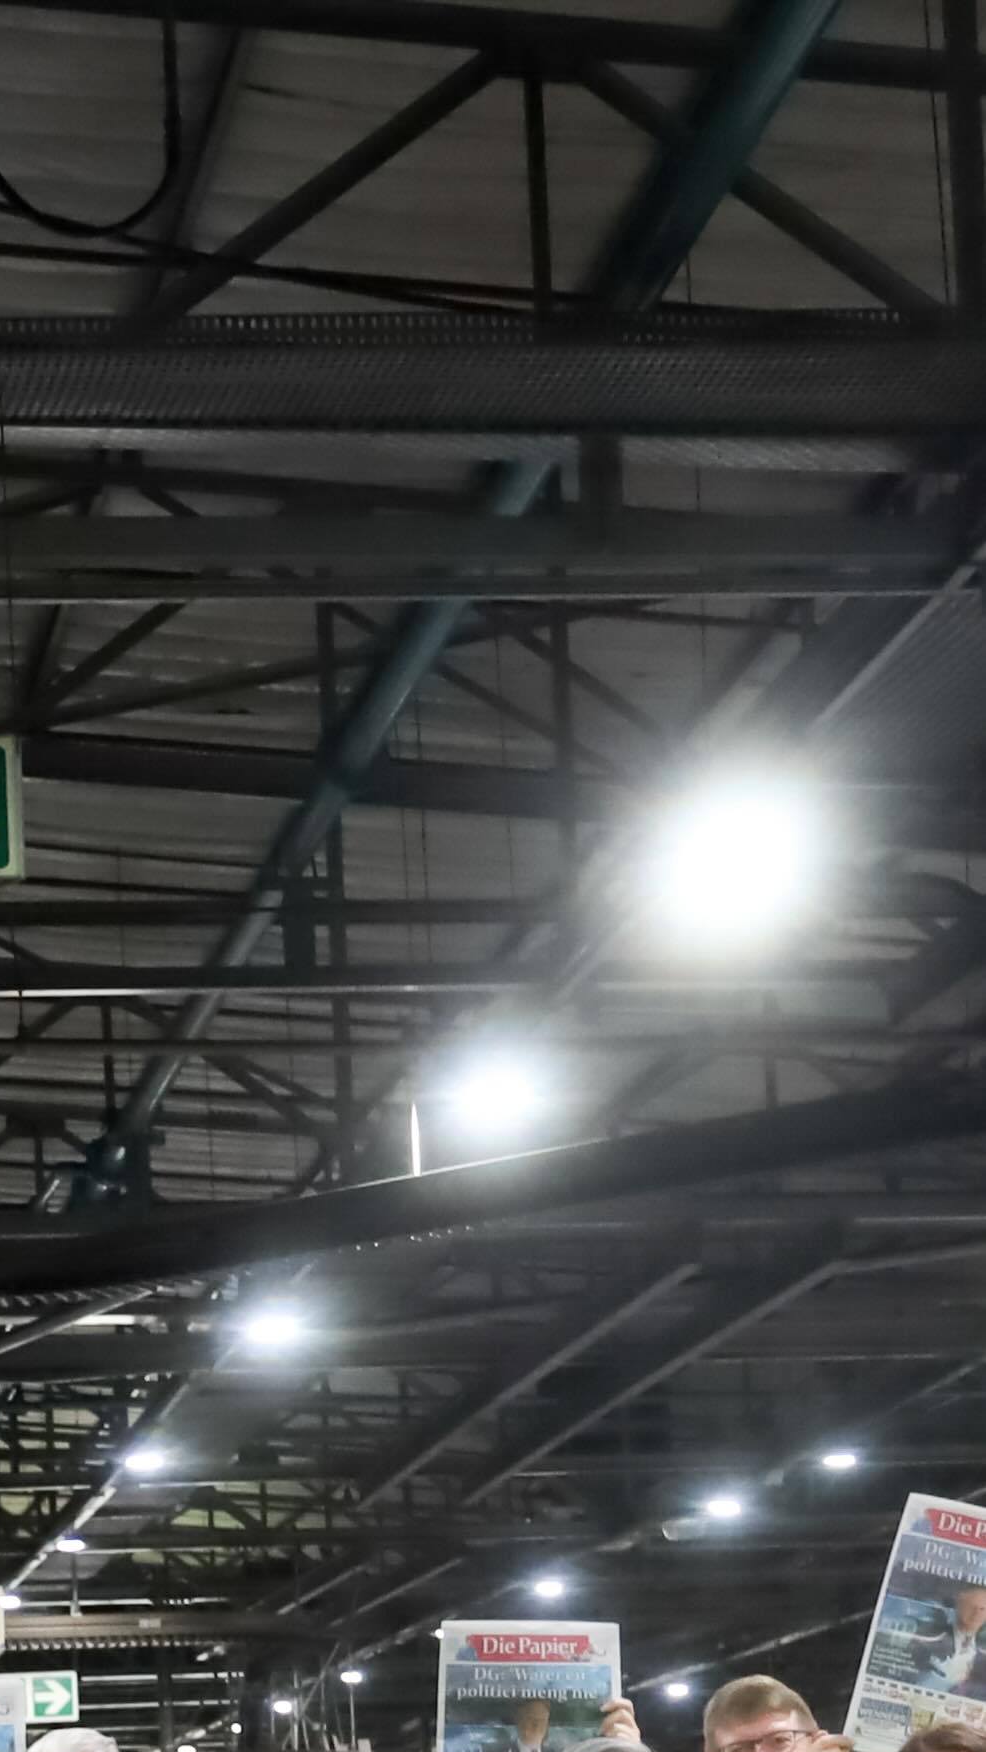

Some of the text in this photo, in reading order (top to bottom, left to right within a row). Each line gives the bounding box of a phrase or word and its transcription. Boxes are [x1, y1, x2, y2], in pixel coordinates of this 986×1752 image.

[938, 1512, 973, 1536] Die
[482, 1635, 578, 1659] Die Papier
[565, 1668, 586, 1681] en
[456, 1683, 516, 1700] politici
[521, 1686, 567, 1701] meng
